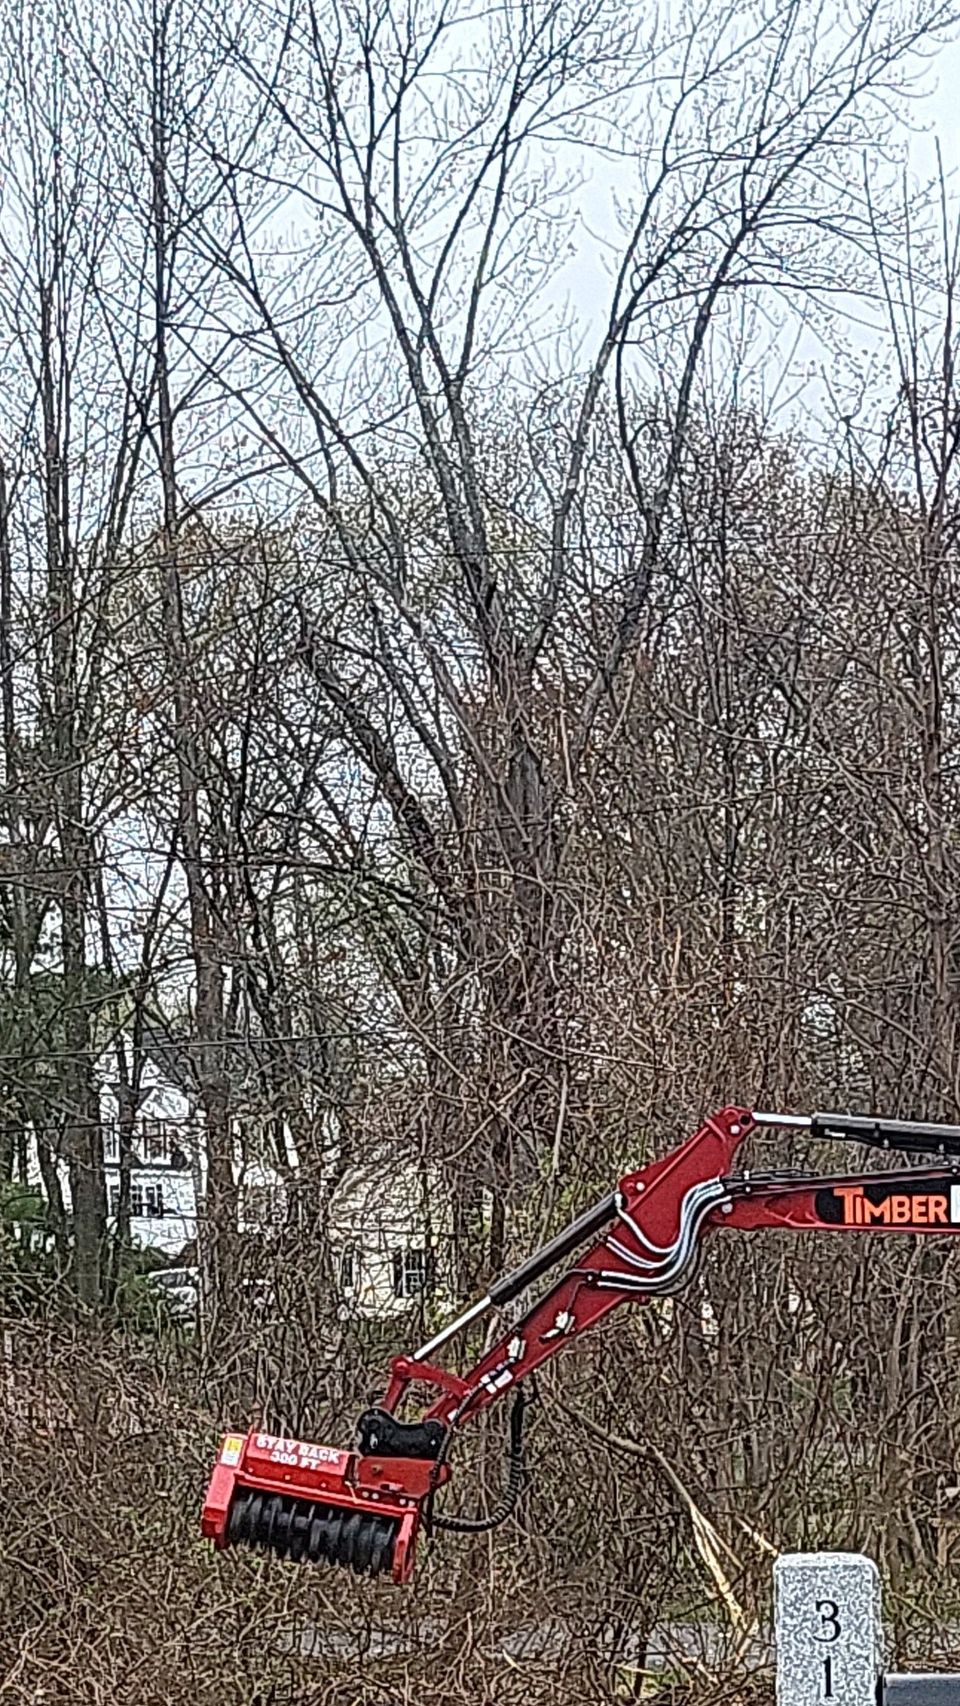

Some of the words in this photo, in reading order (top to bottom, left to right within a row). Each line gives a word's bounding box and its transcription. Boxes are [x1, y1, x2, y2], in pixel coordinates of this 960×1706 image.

[256, 1435, 297, 1454] STAY
[298, 1442, 340, 1464] BACK
[270, 1451, 298, 1466] 300
[299, 1457, 321, 1470] FT
